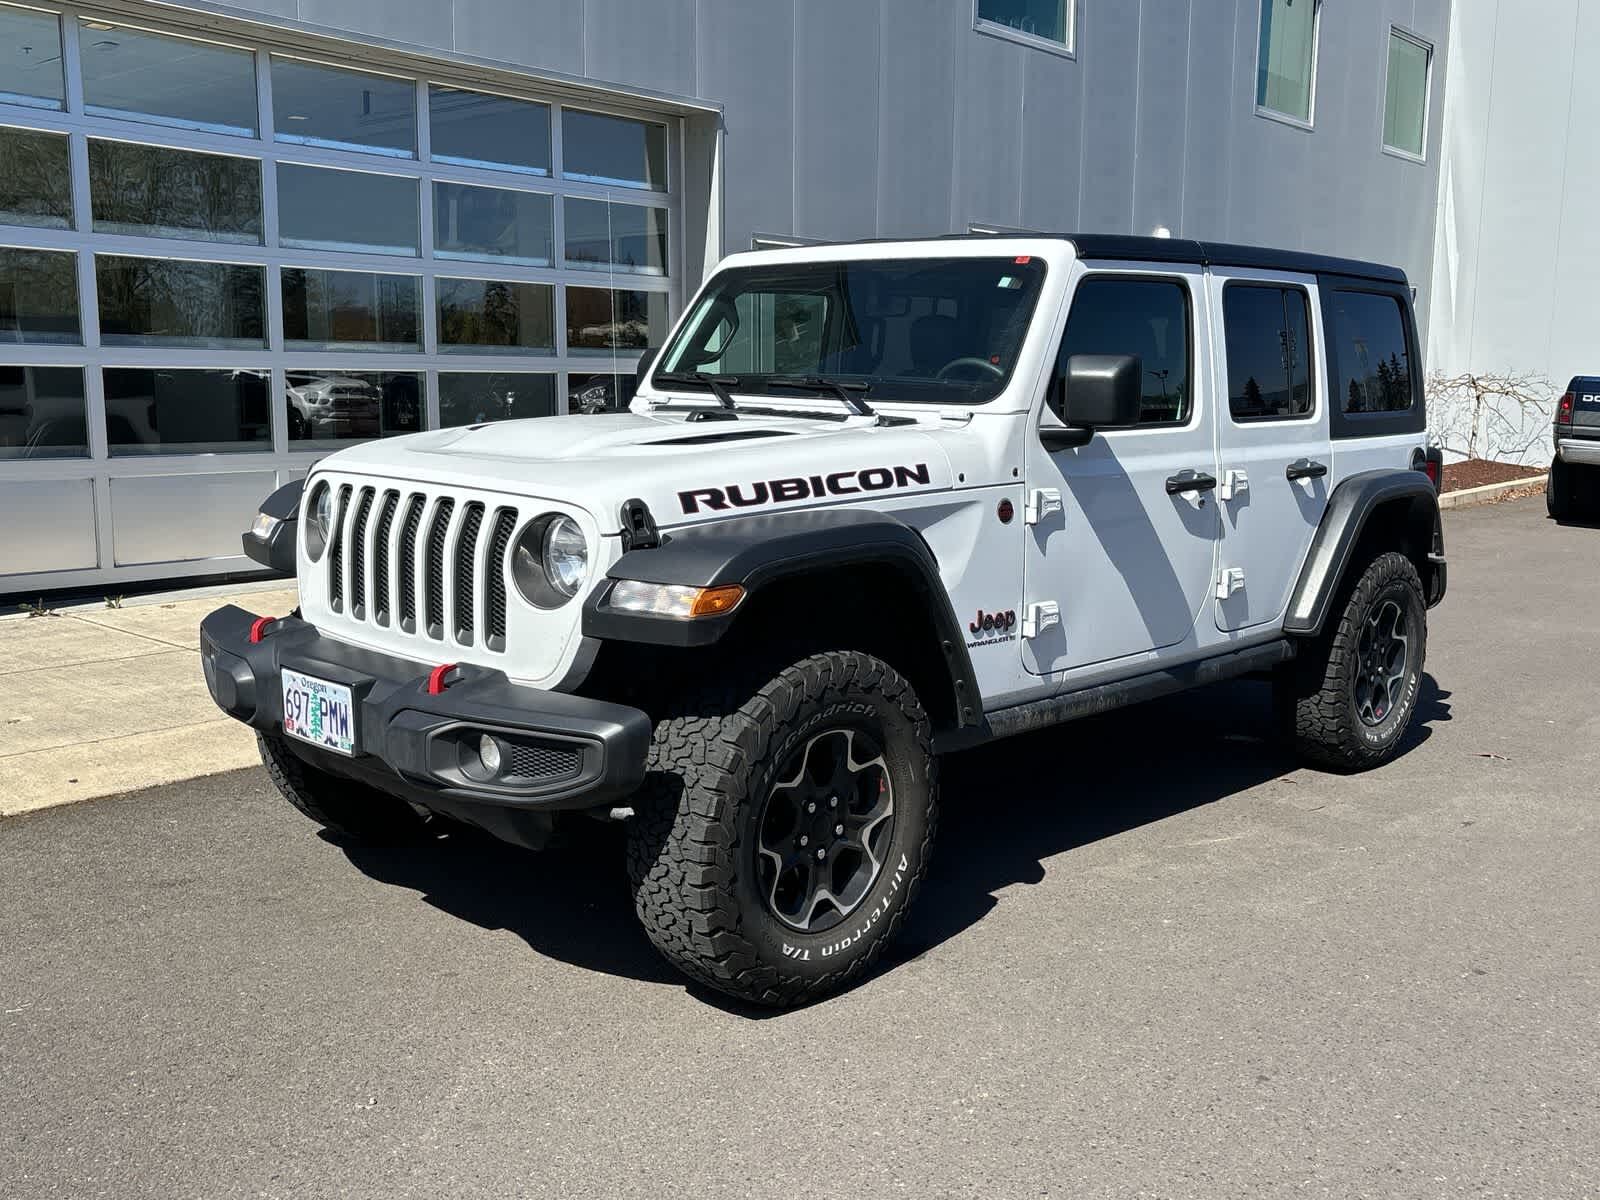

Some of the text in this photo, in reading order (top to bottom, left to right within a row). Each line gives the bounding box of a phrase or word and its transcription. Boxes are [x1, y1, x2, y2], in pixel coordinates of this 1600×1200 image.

[677, 463, 931, 515] RUBICON
[969, 609, 1015, 633] Jeep
[301, 677, 328, 694] Oregon
[286, 687, 349, 739] 697 PMW
[782, 852, 909, 961] All-Terrain T/A
